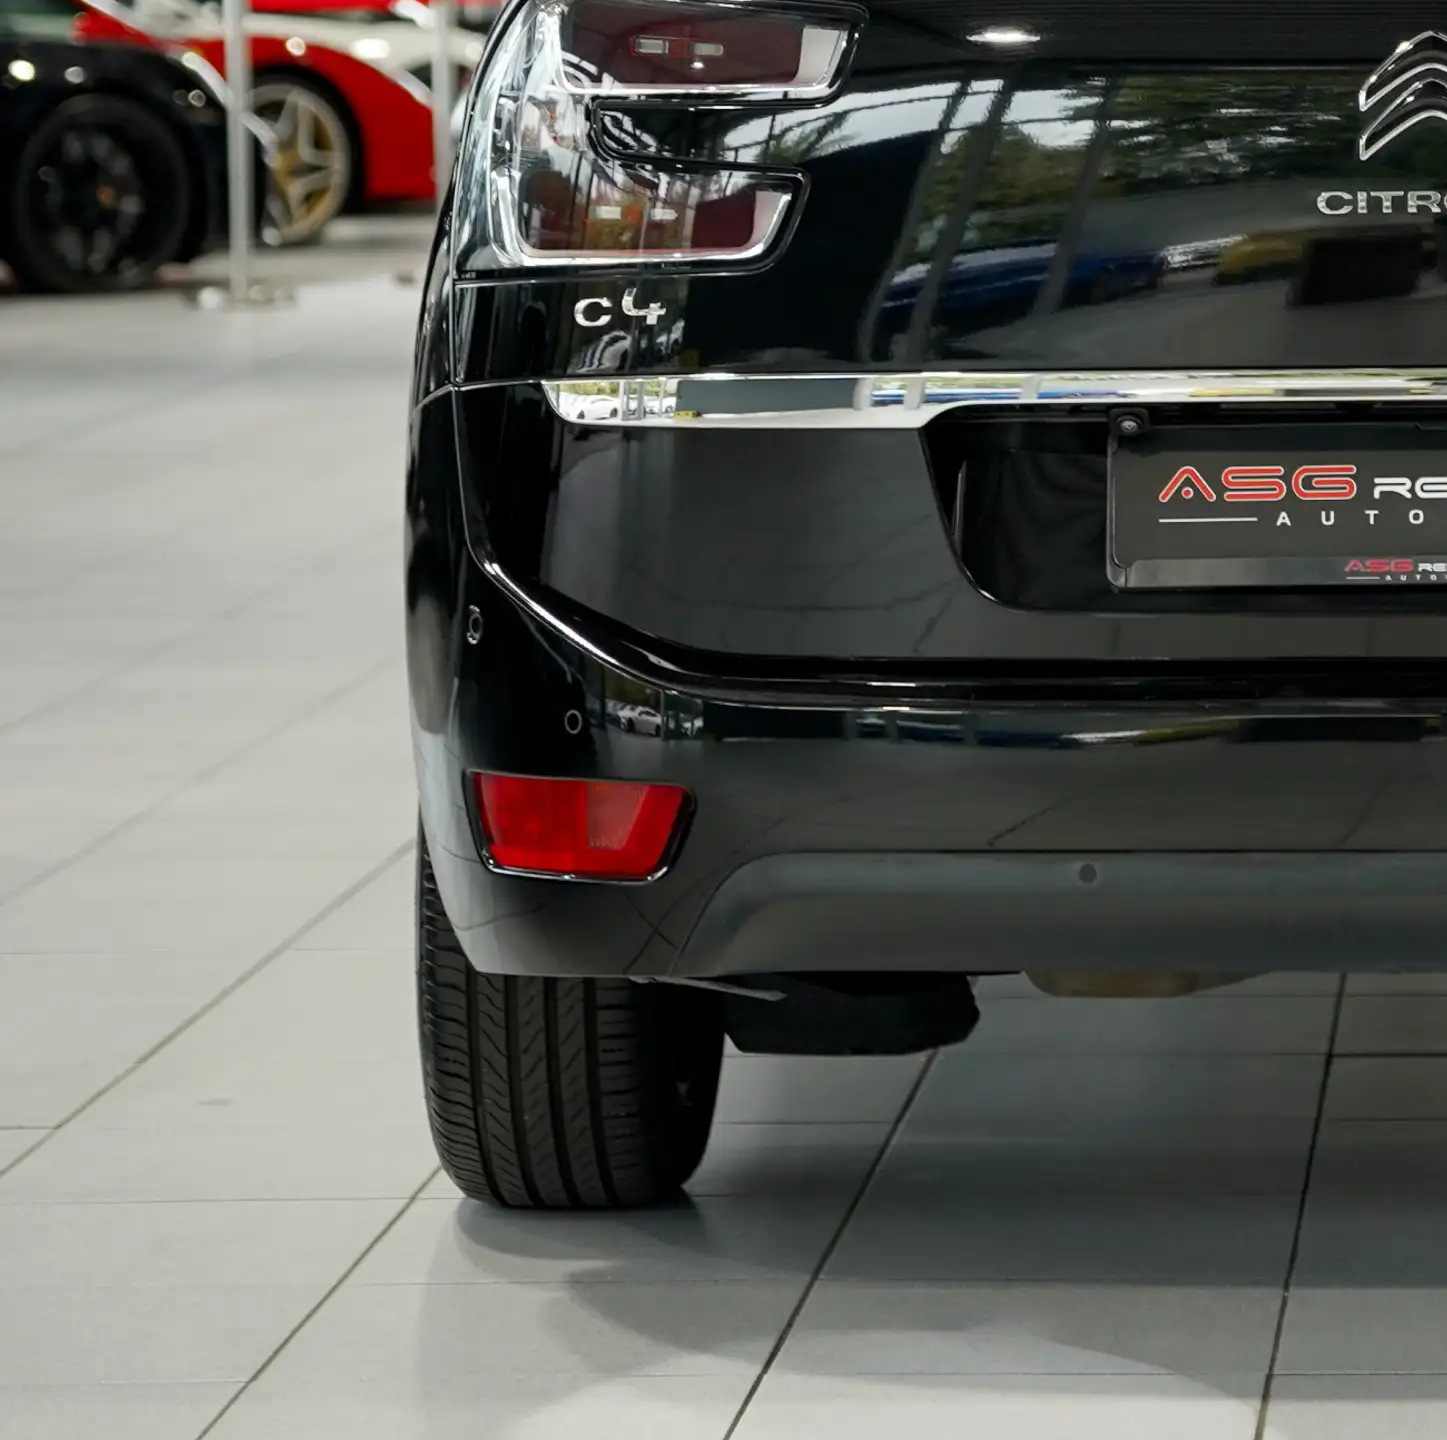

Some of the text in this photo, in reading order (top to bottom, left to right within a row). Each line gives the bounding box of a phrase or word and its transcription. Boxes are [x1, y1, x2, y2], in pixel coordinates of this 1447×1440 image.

[573, 287, 667, 327] C4
[1157, 464, 1358, 503] ASG
[1344, 558, 1414, 573] ASG
